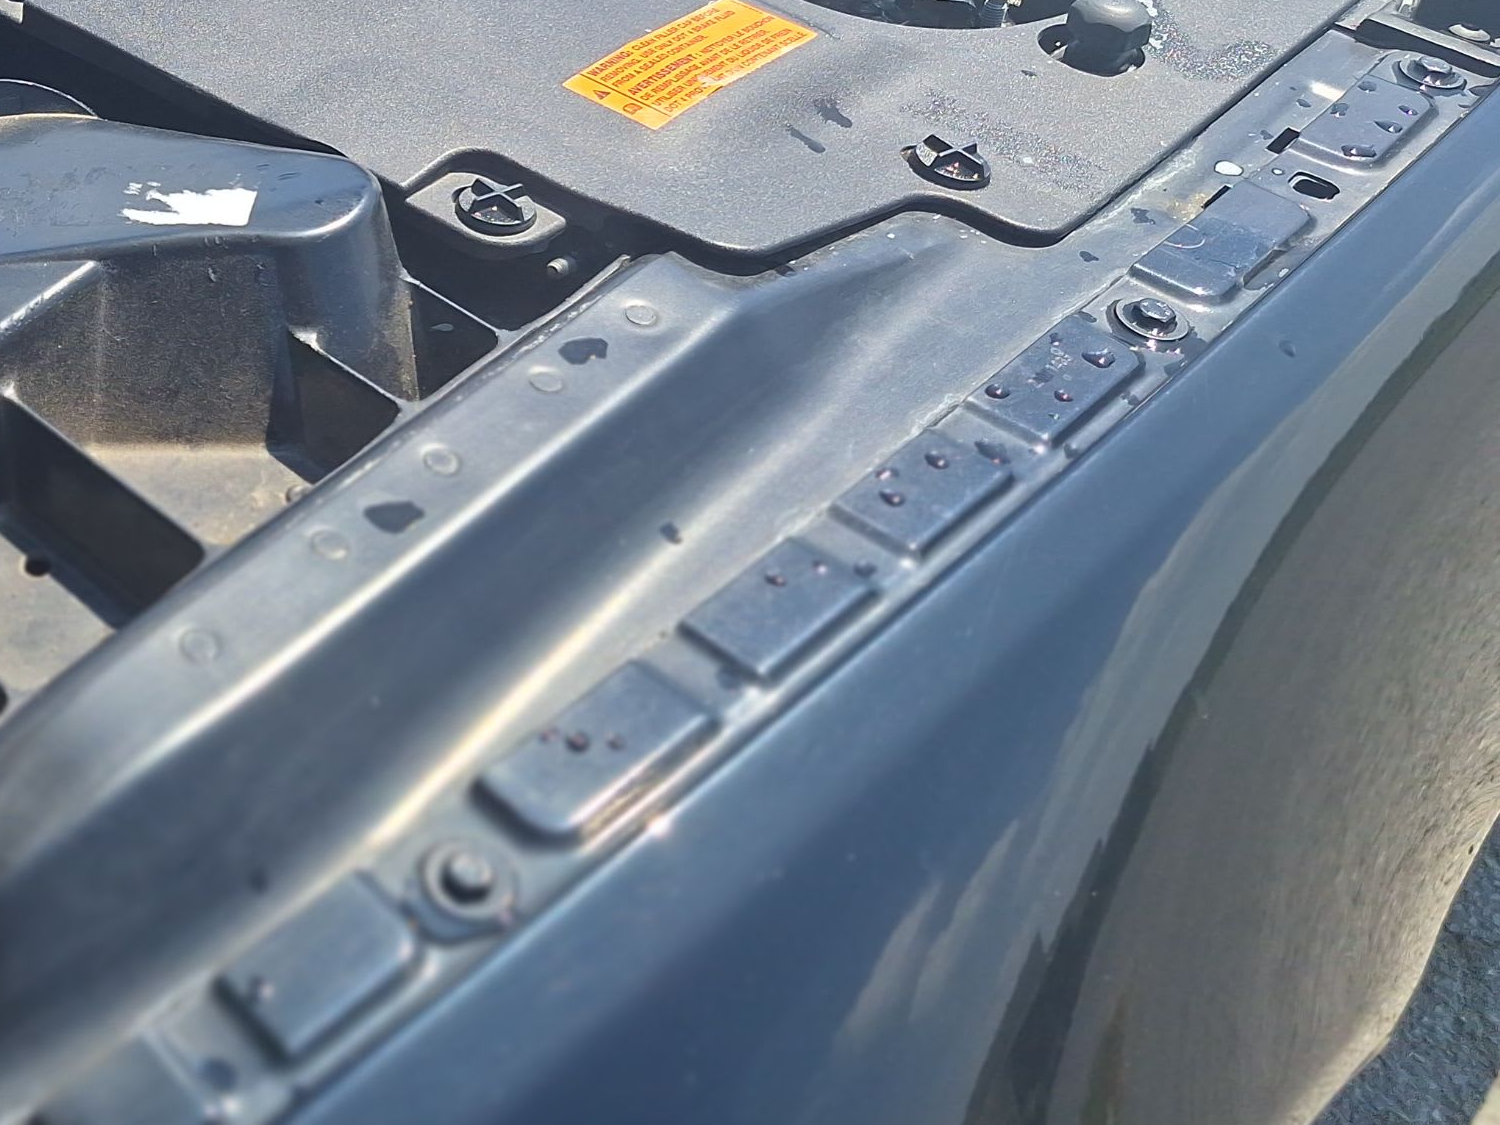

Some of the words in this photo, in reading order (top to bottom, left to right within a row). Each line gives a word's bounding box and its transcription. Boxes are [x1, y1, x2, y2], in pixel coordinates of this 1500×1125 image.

[587, 50, 634, 76] WARNING:
[630, 38, 656, 51] CLEAN
[653, 26, 678, 40] FILLER
[676, 19, 692, 29] CAP
[690, 7, 721, 22] BEFORE
[627, 53, 697, 95] AVERTISSEMENT
[699, 35, 735, 53] NETTOYER
[731, 30, 745, 38] LE
[741, 15, 774, 33] BOUCHON
[638, 48, 658, 59] USE
[653, 39, 674, 51] ONLY
[670, 32, 688, 42] DOT
[691, 19, 717, 32] BRAKE
[713, 10, 736, 22] FLUID
[651, 84, 686, 106] UTILISER
[725, 55, 739, 63] DU
[735, 42, 765, 58] LIQUIDE
[760, 37, 775, 45] DE
[769, 28, 792, 40] FREIN
[611, 72, 636, 88] FROM
[638, 53, 669, 71] SEALED
[639, 92, 655, 101] DE
[651, 63, 702, 94] REMPLISSAGE
[698, 52, 721, 66] AVANT
[718, 47, 733, 55] DE
[729, 42, 742, 50] LE
[663, 99, 682, 113] DOT
[740, 43, 781, 67] CONTENANT
